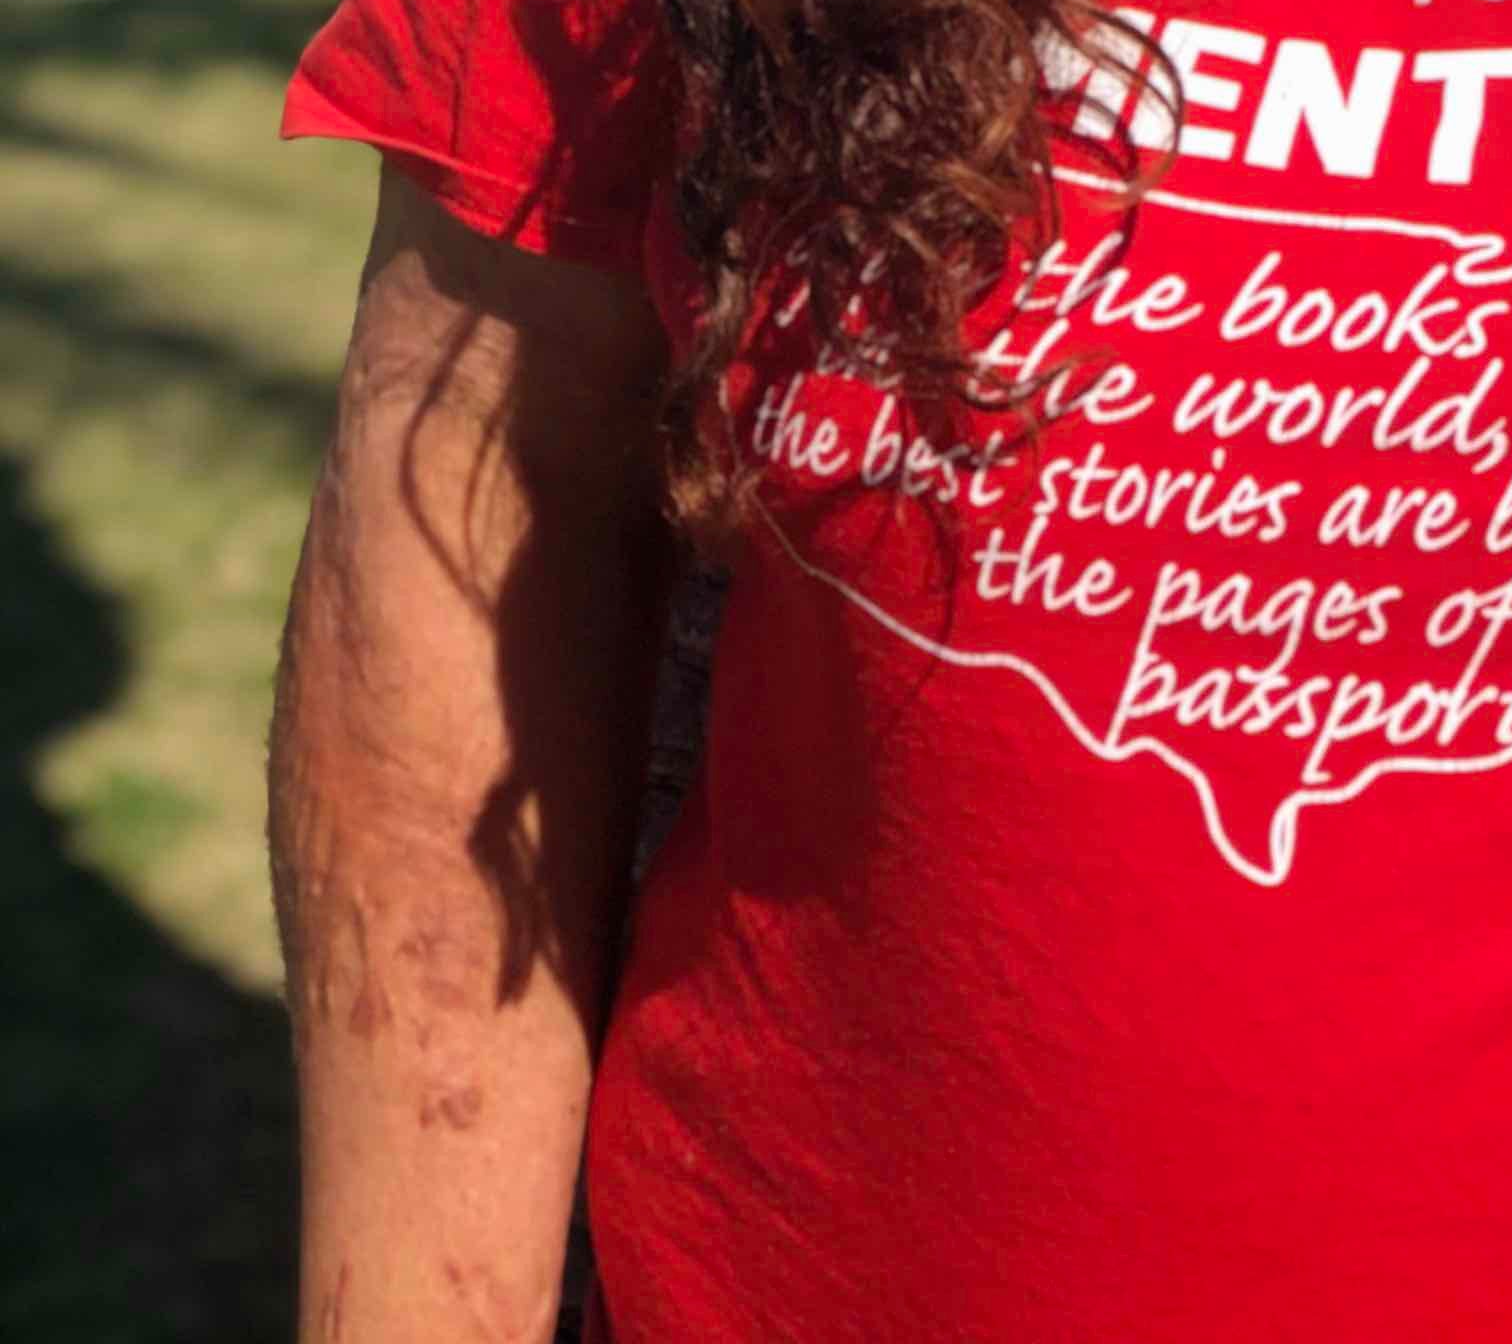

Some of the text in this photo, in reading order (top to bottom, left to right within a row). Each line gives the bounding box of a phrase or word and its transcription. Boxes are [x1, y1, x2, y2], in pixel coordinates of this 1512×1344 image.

[1013, 231, 1204, 332] the
[1219, 252, 1510, 358] books
[752, 371, 851, 476] the
[861, 392, 1020, 506] best
[1032, 442, 1302, 542] stories
[1318, 484, 1472, 552] are
[964, 317, 1155, 424] the
[1173, 355, 1511, 474] world,
[972, 512, 1134, 616] the
[1140, 562, 1403, 677] pages
